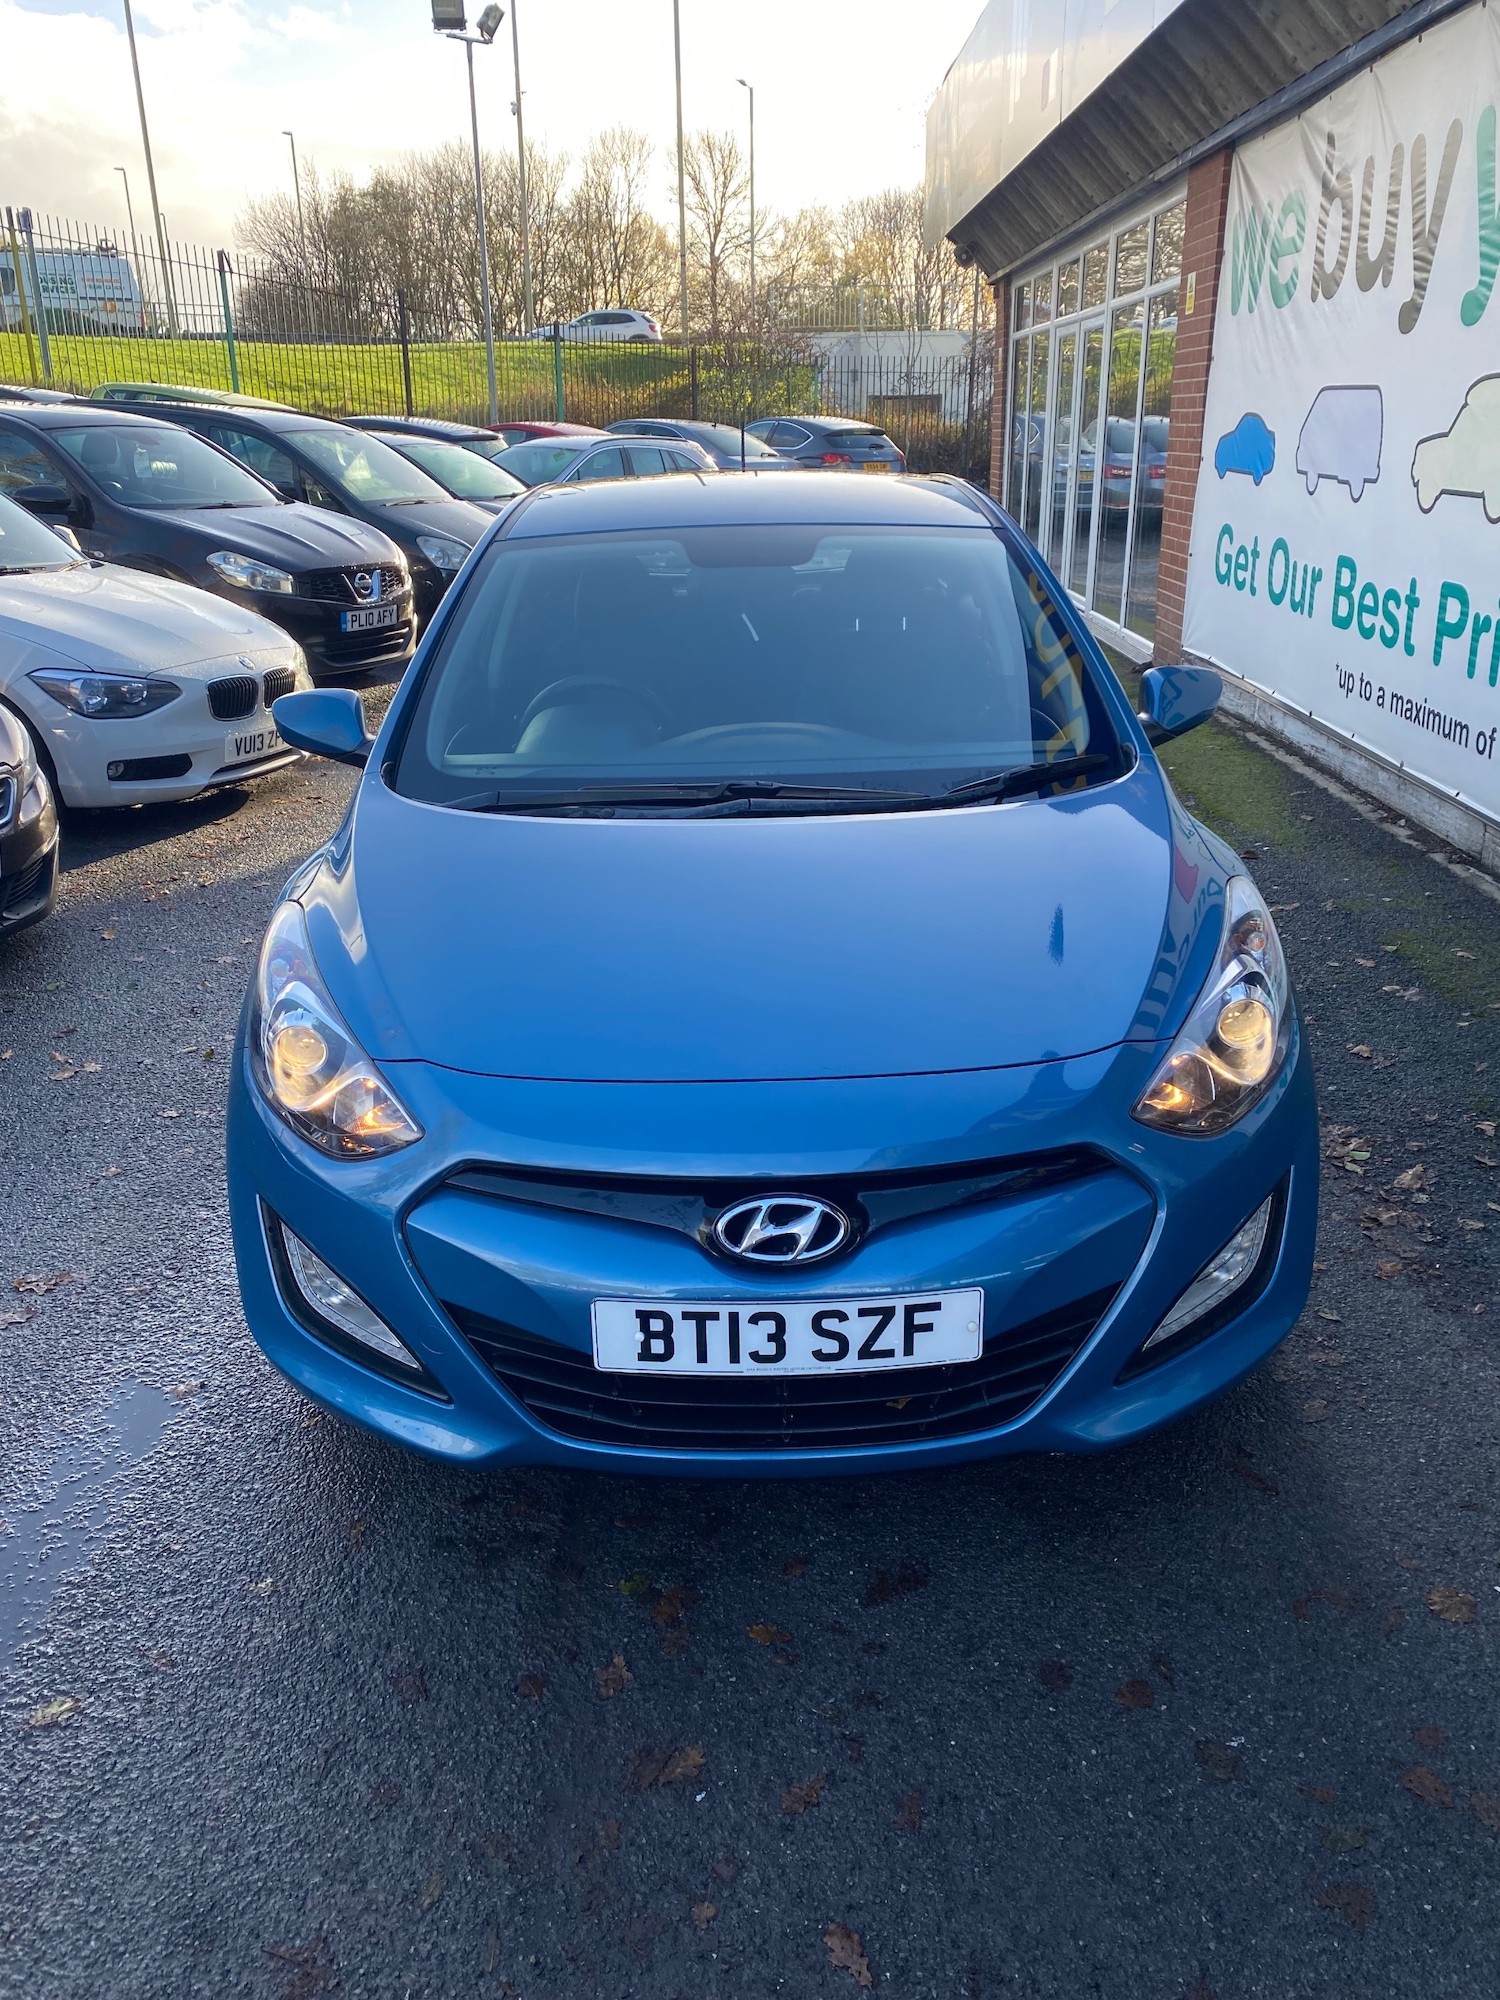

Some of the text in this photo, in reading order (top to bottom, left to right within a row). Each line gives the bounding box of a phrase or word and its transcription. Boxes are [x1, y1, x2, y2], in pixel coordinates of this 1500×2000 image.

[350, 608, 394, 628] PL10 AFY
[1215, 523, 1260, 597] Get
[1268, 537, 1323, 618] Our
[1331, 554, 1420, 656] Best
[234, 733, 265, 756] VU13
[1359, 672, 1373, 702] to
[1376, 686, 1386, 709] a
[1390, 691, 1470, 749] maximum
[1475, 726, 1498, 760] of
[634, 1301, 942, 1364] BT13 SZF
